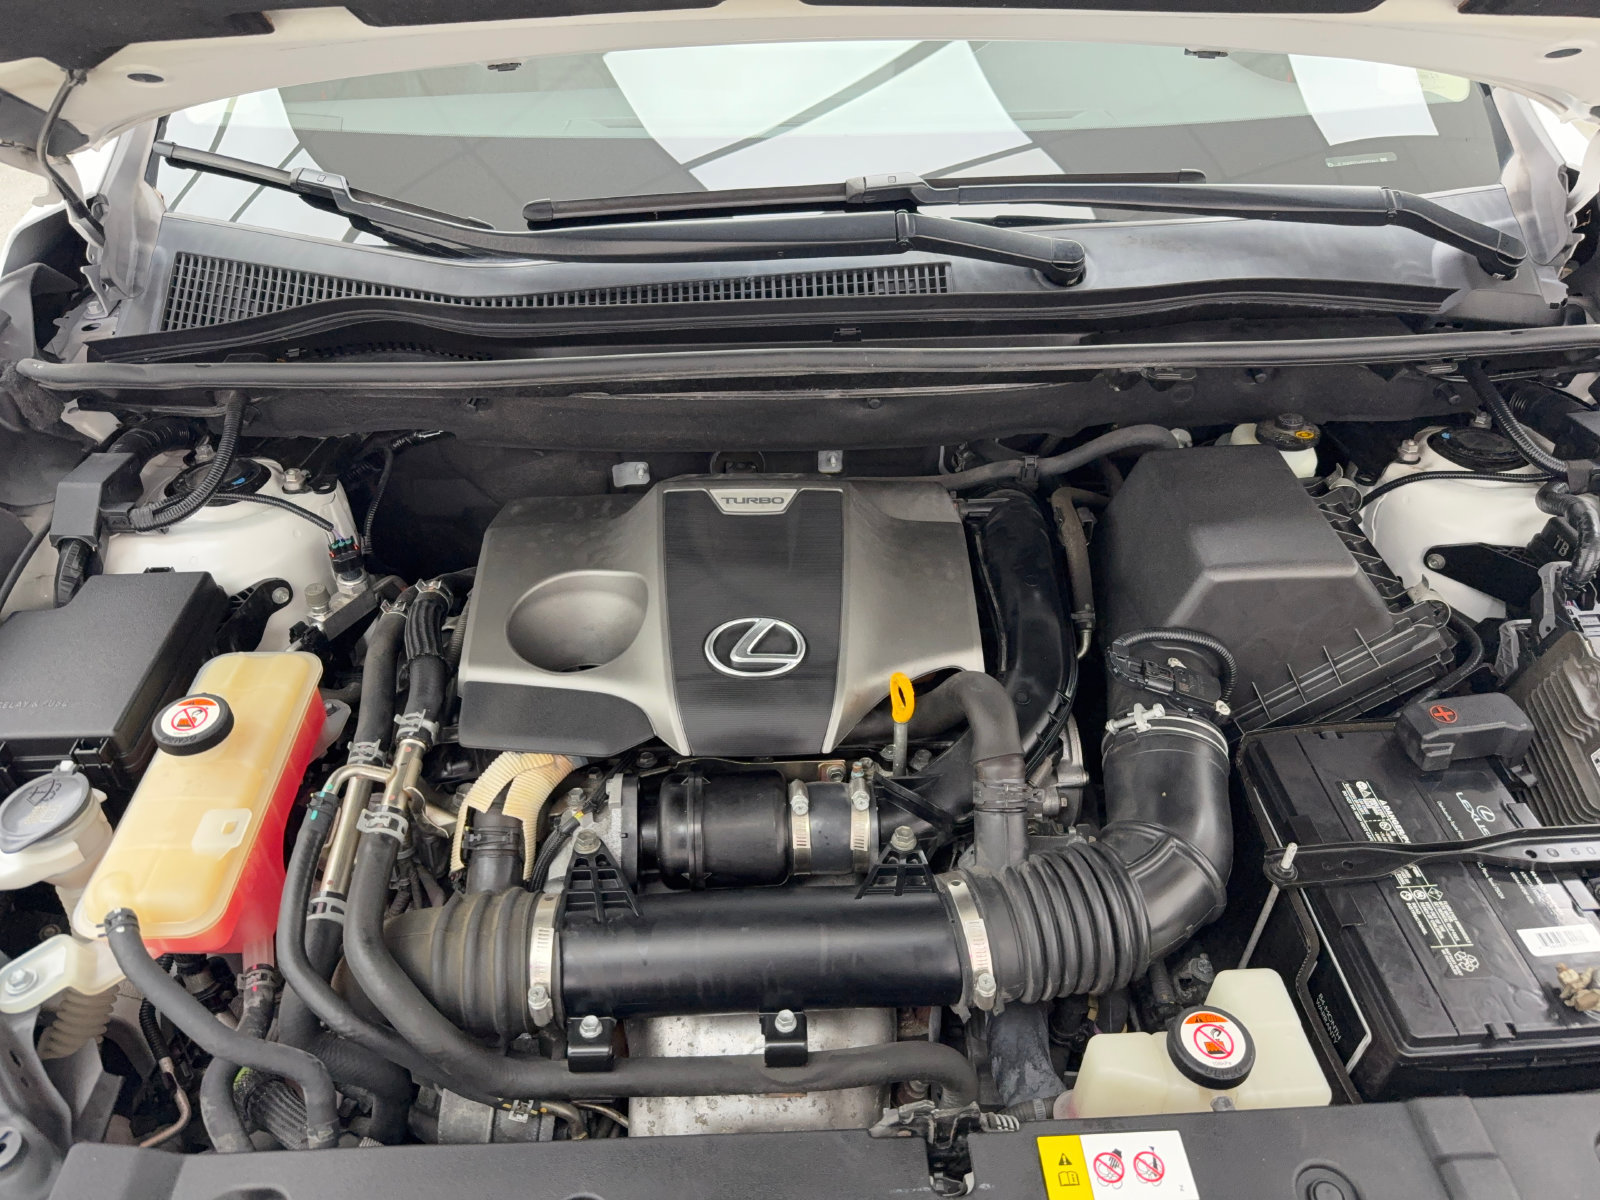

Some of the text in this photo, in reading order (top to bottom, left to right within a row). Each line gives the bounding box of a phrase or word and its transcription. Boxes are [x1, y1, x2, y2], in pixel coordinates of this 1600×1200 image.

[721, 496, 785, 505] TURBO
[1553, 533, 1570, 557] TB
[1455, 791, 1491, 837] LEXUS
